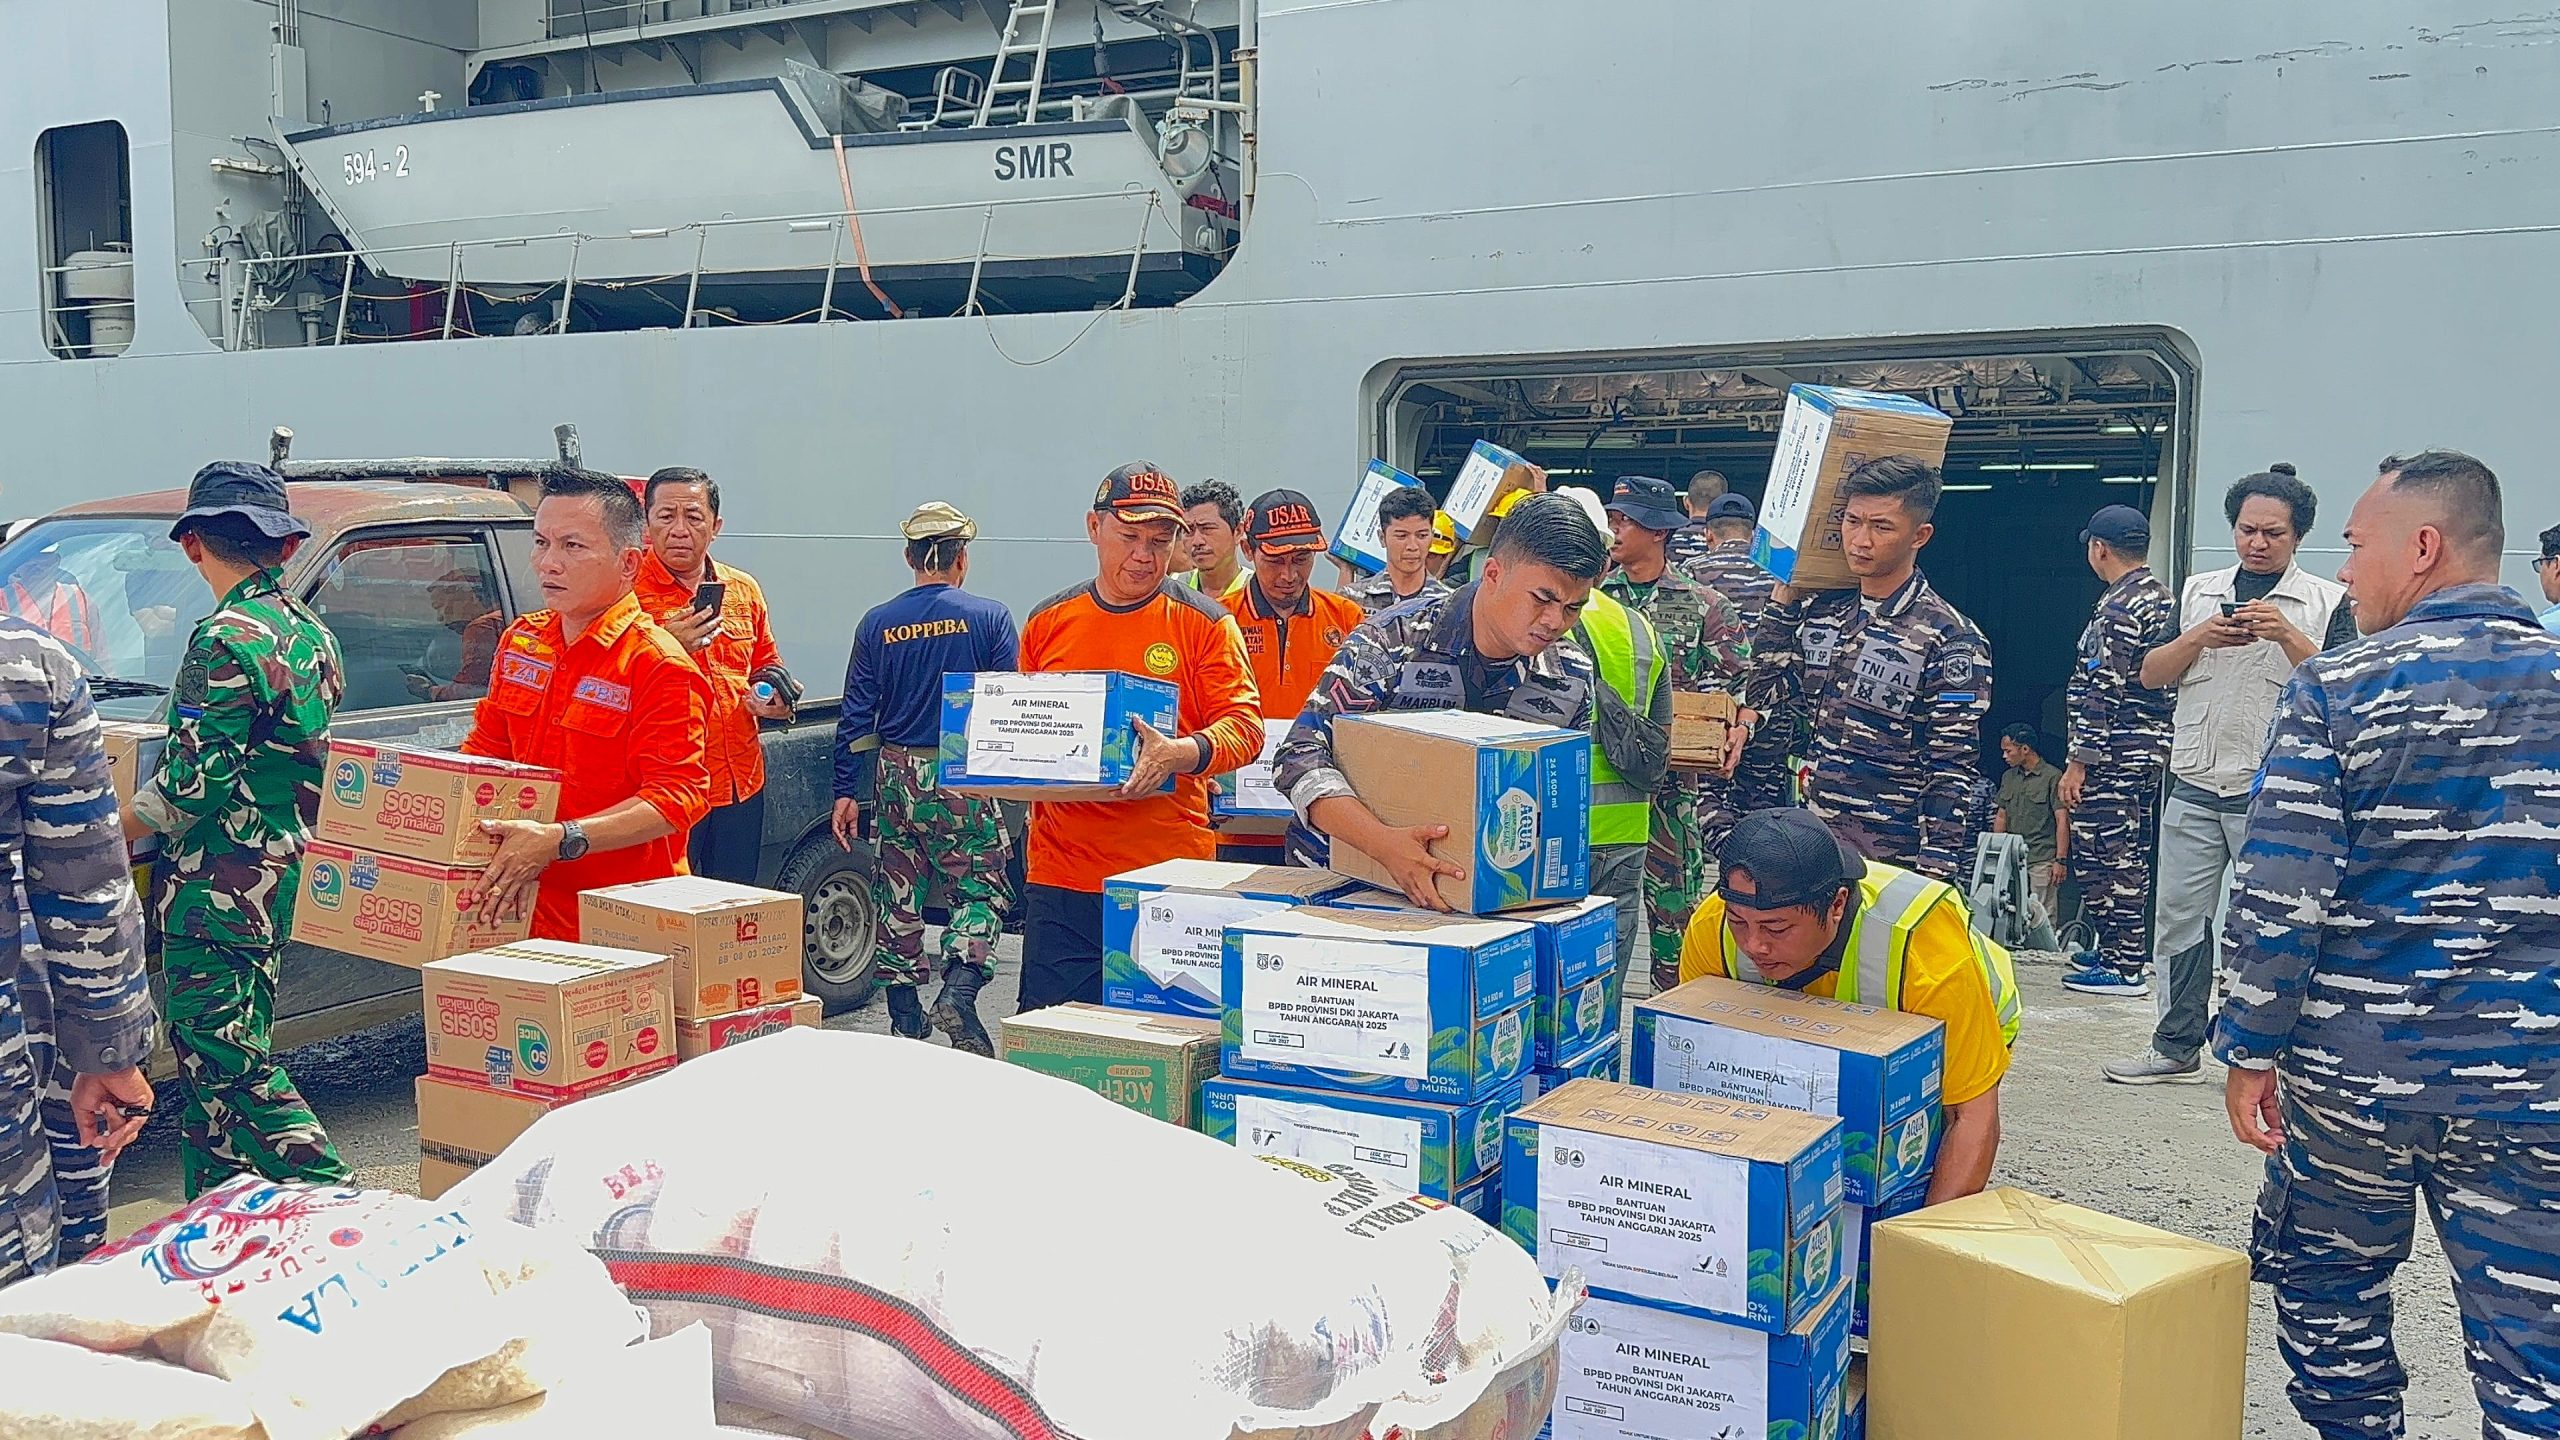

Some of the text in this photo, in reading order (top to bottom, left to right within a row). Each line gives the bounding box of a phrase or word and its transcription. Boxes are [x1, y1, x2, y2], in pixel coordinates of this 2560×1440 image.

[343, 148, 378, 186] 594
[395, 144, 410, 178] 2
[994, 142, 1075, 181] SMR
[1129, 471, 1178, 499] USAR
[1267, 504, 1312, 526] USAR
[883, 618, 969, 645] KOPPEBA
[1861, 659, 1912, 688] TNI AL
[1012, 699, 1070, 709] AIR MINERAL
[1020, 728, 1057, 736] ANGGARAN
[378, 751, 400, 764] LEBIH
[1550, 758, 1557, 770] 24
[336, 767, 355, 782] SO
[373, 772, 384, 782] +1
[339, 788, 363, 801] NICE
[1551, 798, 1558, 809] ml
[384, 790, 445, 820] SOSIS
[377, 811, 444, 835] siap makan
[1519, 804, 1533, 852] AQUA
[354, 854, 375, 866] LEBIH
[313, 868, 330, 883] SO
[350, 875, 361, 885] +1
[316, 891, 340, 904] NICE
[360, 893, 423, 926] SOSIS
[353, 915, 422, 942] siap makan
[1184, 926, 1203, 936] AIR
[1161, 949, 1220, 960] BPBD PROVINSI
[1171, 958, 1197, 967] TAHUN
[1296, 975, 1378, 992] AIR MINERAL
[1311, 995, 1355, 1006] BANTUAN
[1583, 985, 1600, 1005] AQUA
[436, 994, 500, 1018] siap makan
[1268, 1002, 1399, 1021] BPBD PROVINSI DKI JAKARTA
[441, 1008, 499, 1041] SOSIS
[1279, 1013, 1387, 1031] TAHUN ANGGARAN 2025
[1498, 1015, 1517, 1040] AQUA
[518, 1027, 541, 1042] NICE
[531, 1049, 548, 1065] SO
[490, 1072, 513, 1086] LEBIH
[1707, 1061, 1788, 1086] AIR MINERAL
[1421, 1083, 1460, 1095] MURNI
[1679, 1081, 1703, 1093] BPBD
[1705, 1086, 1749, 1102] PROVINSI
[1749, 1096, 1765, 1106] DKI
[1720, 1080, 1764, 1096] BANTUAN
[1906, 1114, 1924, 1139] AQUA
[1480, 1144, 1500, 1168] AQUA
[1599, 1174, 1692, 1200] AIR MINERAL
[1615, 1197, 1666, 1213] BANTUAN
[1567, 1199, 1716, 1234] BPBD PROVINSI DKI JAKARTA
[1580, 1212, 1702, 1243] TAHUN ANGGARAN 2025
[1615, 1342, 1711, 1370] AIR MINERAL
[1632, 1365, 1684, 1383] BANTUAN
[1583, 1367, 1735, 1404] BPBD PROVINSI DKI JAKARTA
[1595, 1380, 1721, 1412] TAHUN ANGGARAN 2025
